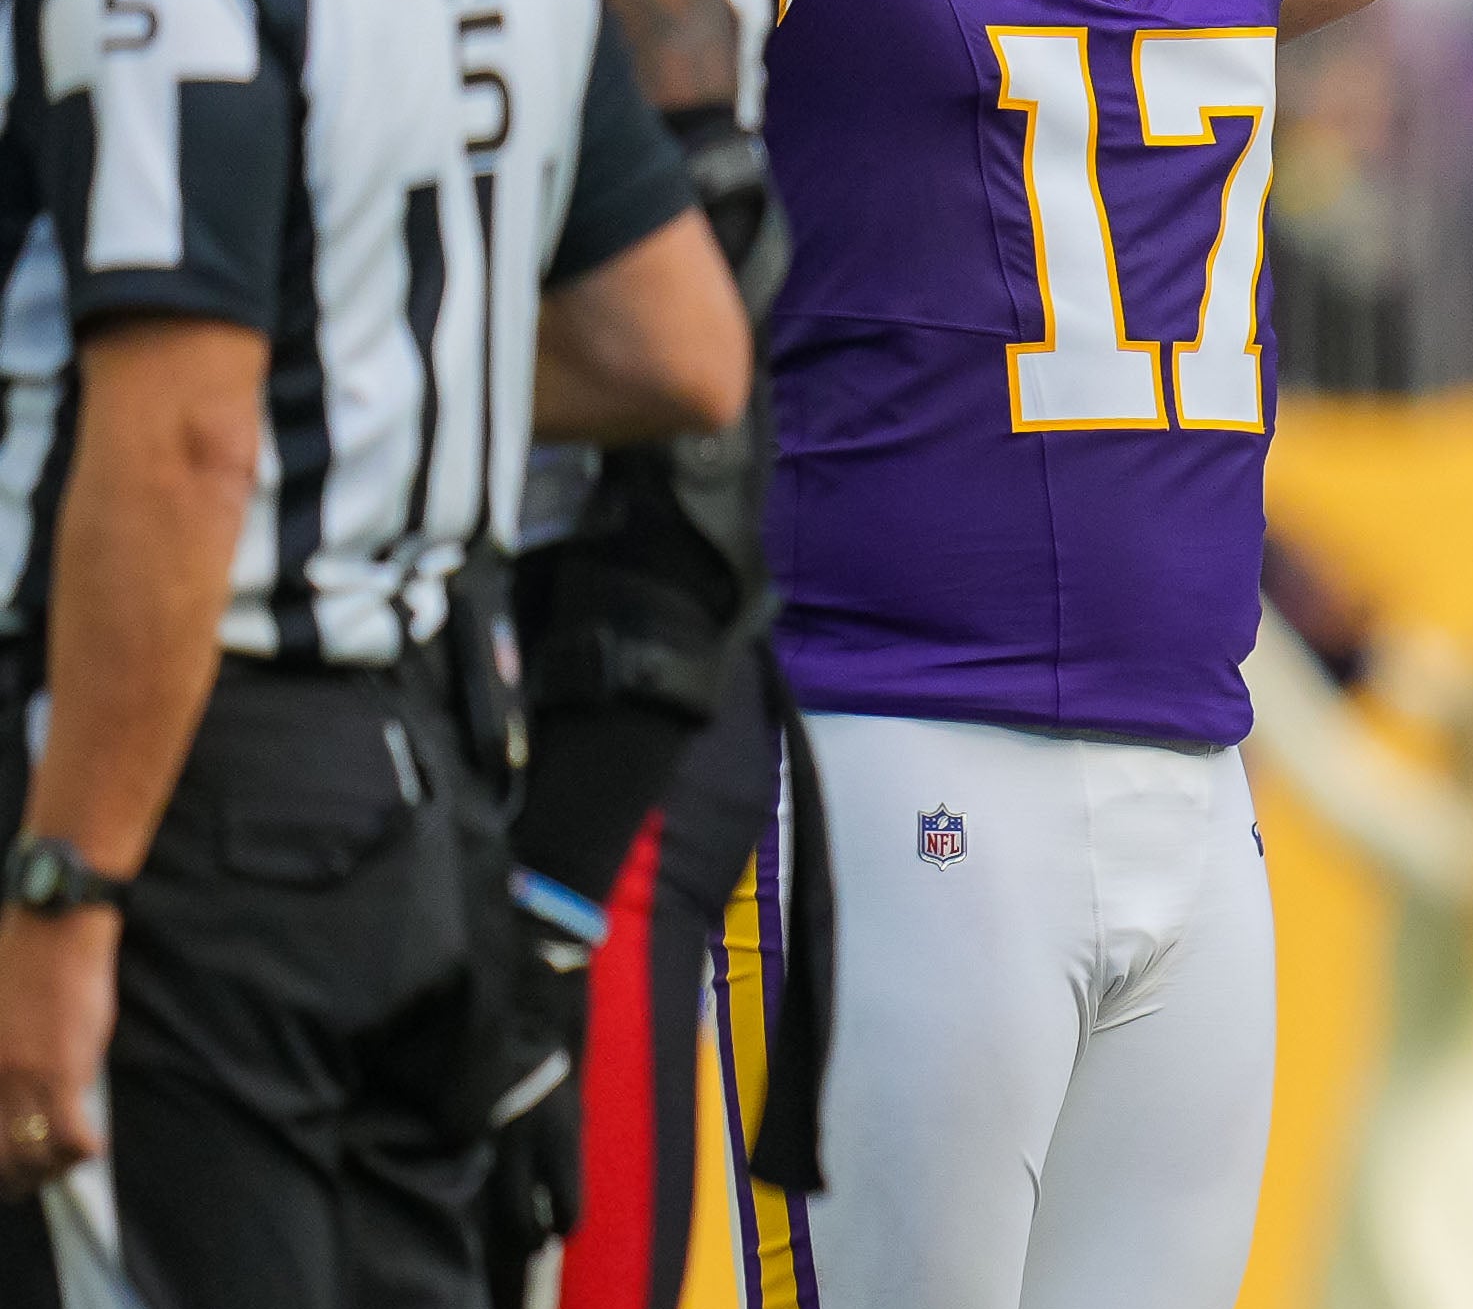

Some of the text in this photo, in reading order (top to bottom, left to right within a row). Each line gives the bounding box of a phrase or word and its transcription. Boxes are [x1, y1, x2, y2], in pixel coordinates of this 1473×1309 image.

[456, 9, 511, 155] 5
[986, 25, 1278, 435] 17
[926, 832, 960, 858] NFL
